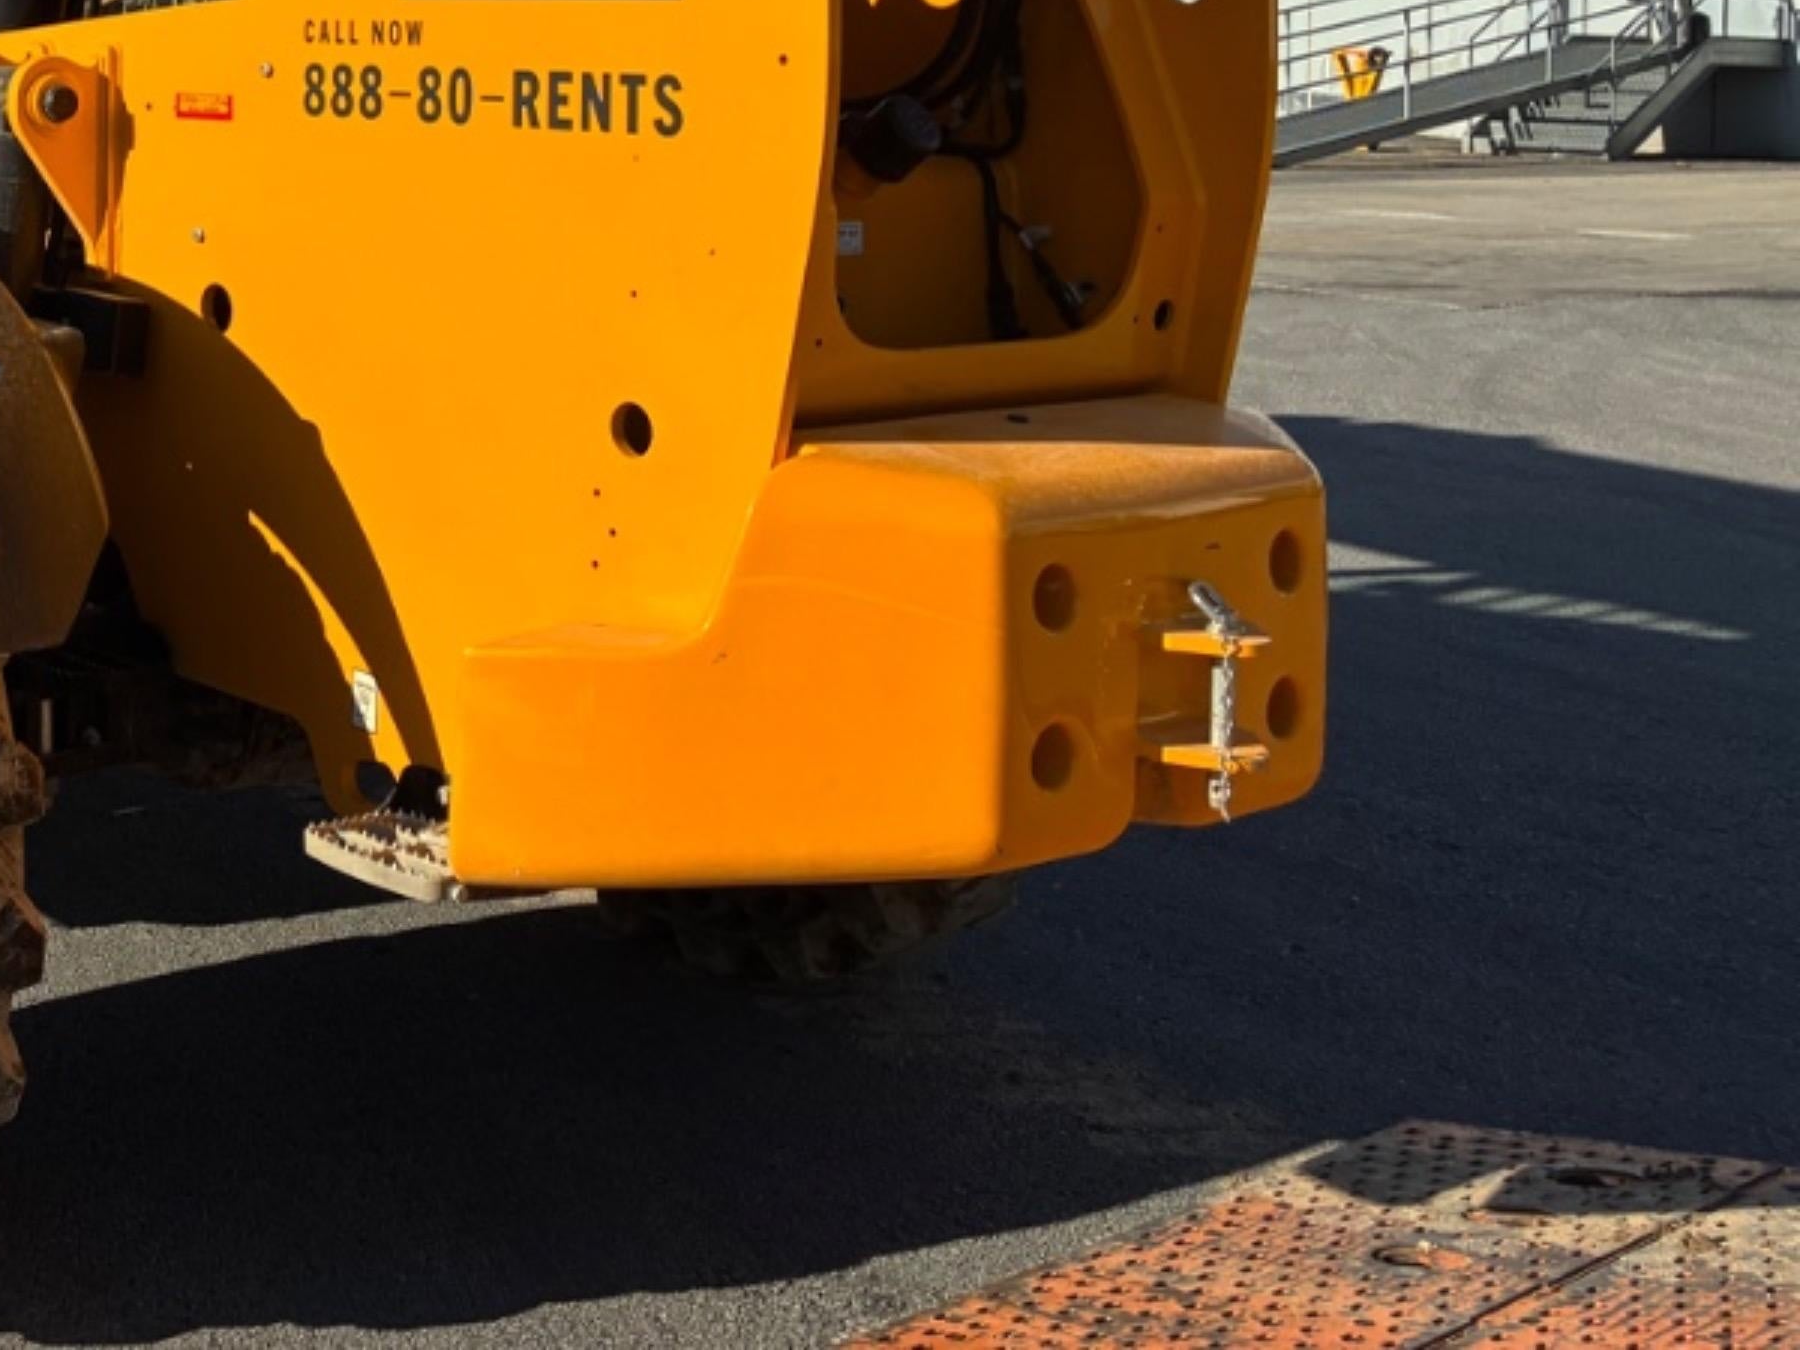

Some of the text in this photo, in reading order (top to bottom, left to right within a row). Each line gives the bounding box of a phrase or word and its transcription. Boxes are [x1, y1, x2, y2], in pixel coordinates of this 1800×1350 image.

[304, 19, 424, 46] CALL NOW
[303, 62, 684, 137] 888-80-RENTS
